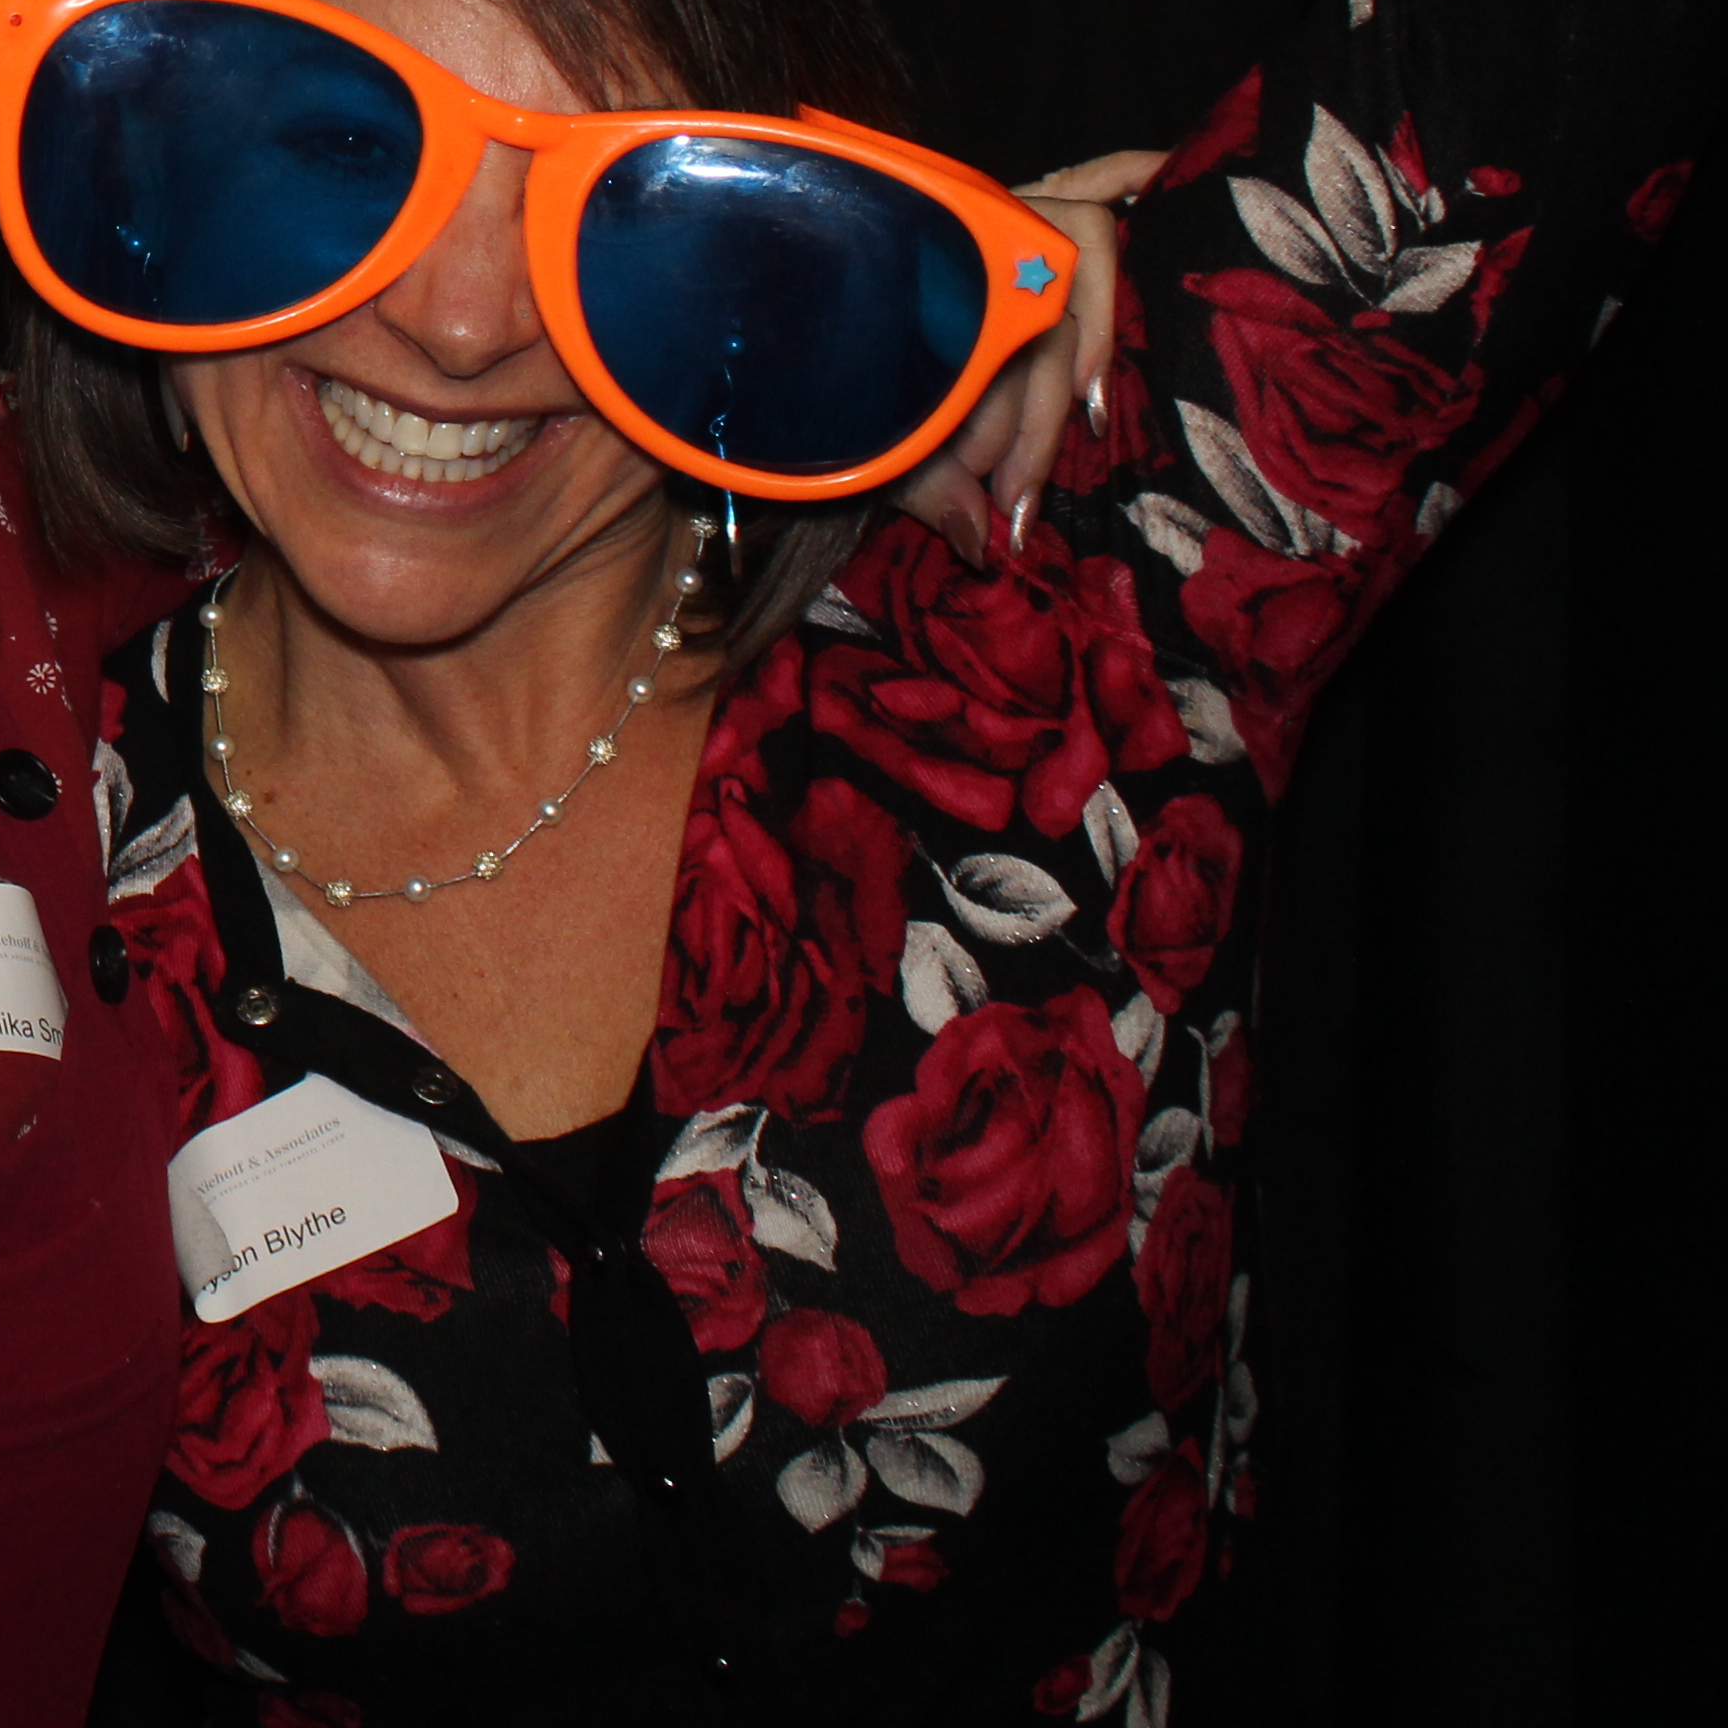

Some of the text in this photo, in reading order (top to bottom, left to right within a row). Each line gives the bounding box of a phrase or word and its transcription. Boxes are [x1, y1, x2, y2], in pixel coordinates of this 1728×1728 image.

[248, 1156, 261, 1170] &
[264, 1117, 341, 1163] Associates
[263, 1206, 346, 1254] Blythe
